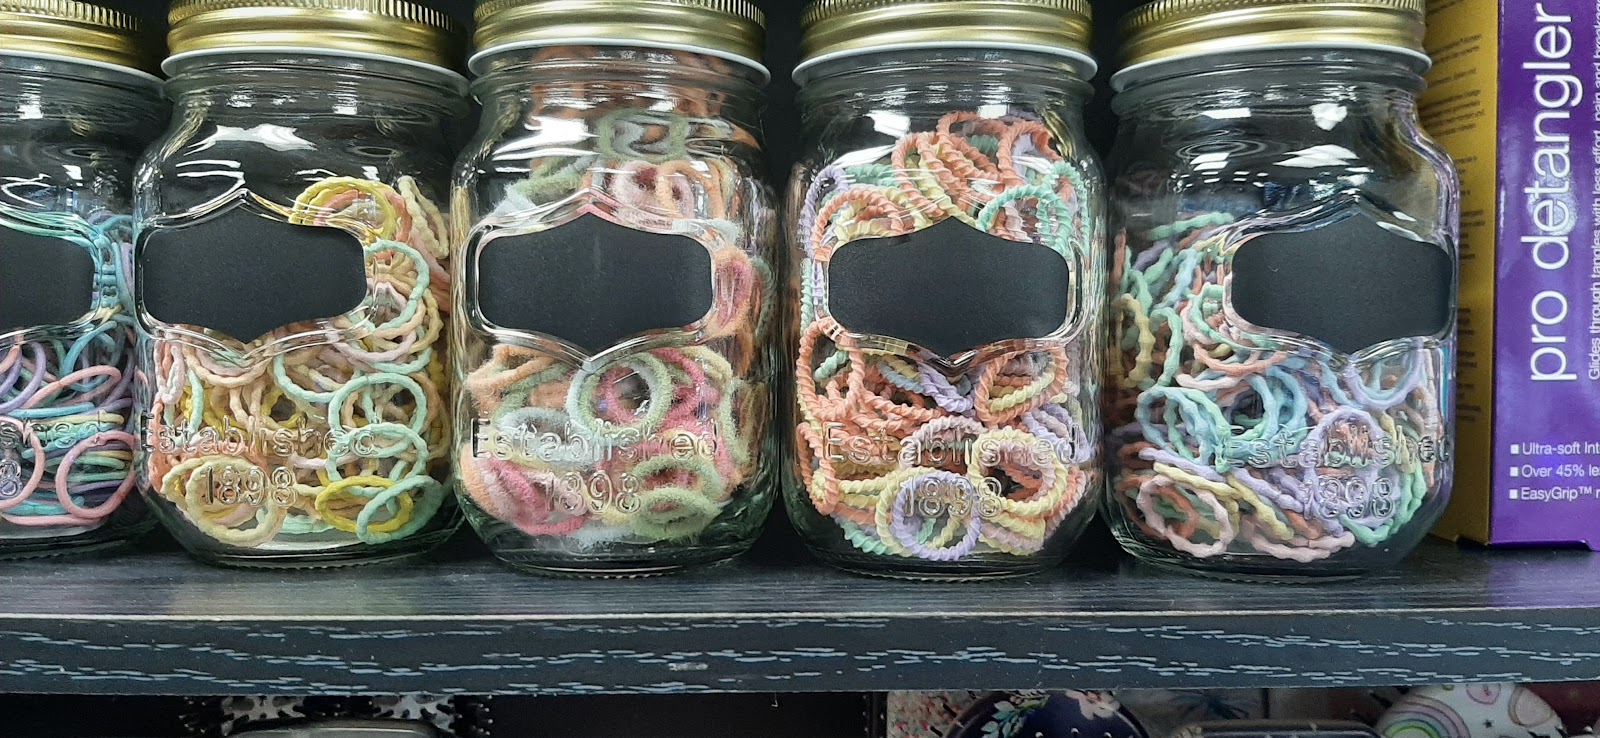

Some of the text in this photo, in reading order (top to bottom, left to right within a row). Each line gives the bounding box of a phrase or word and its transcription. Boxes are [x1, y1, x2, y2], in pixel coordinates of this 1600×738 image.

[1519, 2, 1583, 380] pro detangler
[1592, 197, 1600, 227] with
[1589, 282, 1600, 334] through
[1588, 338, 1600, 380] Glides
[471, 417, 718, 461] Established
[822, 422, 1080, 467] Established
[1522, 441, 1580, 455] Ultra-soft
[203, 465, 299, 507] 1898
[546, 469, 643, 515] 1898
[1521, 464, 1552, 478] Over
[1555, 463, 1585, 478] 45%
[903, 476, 1002, 520] 1898
